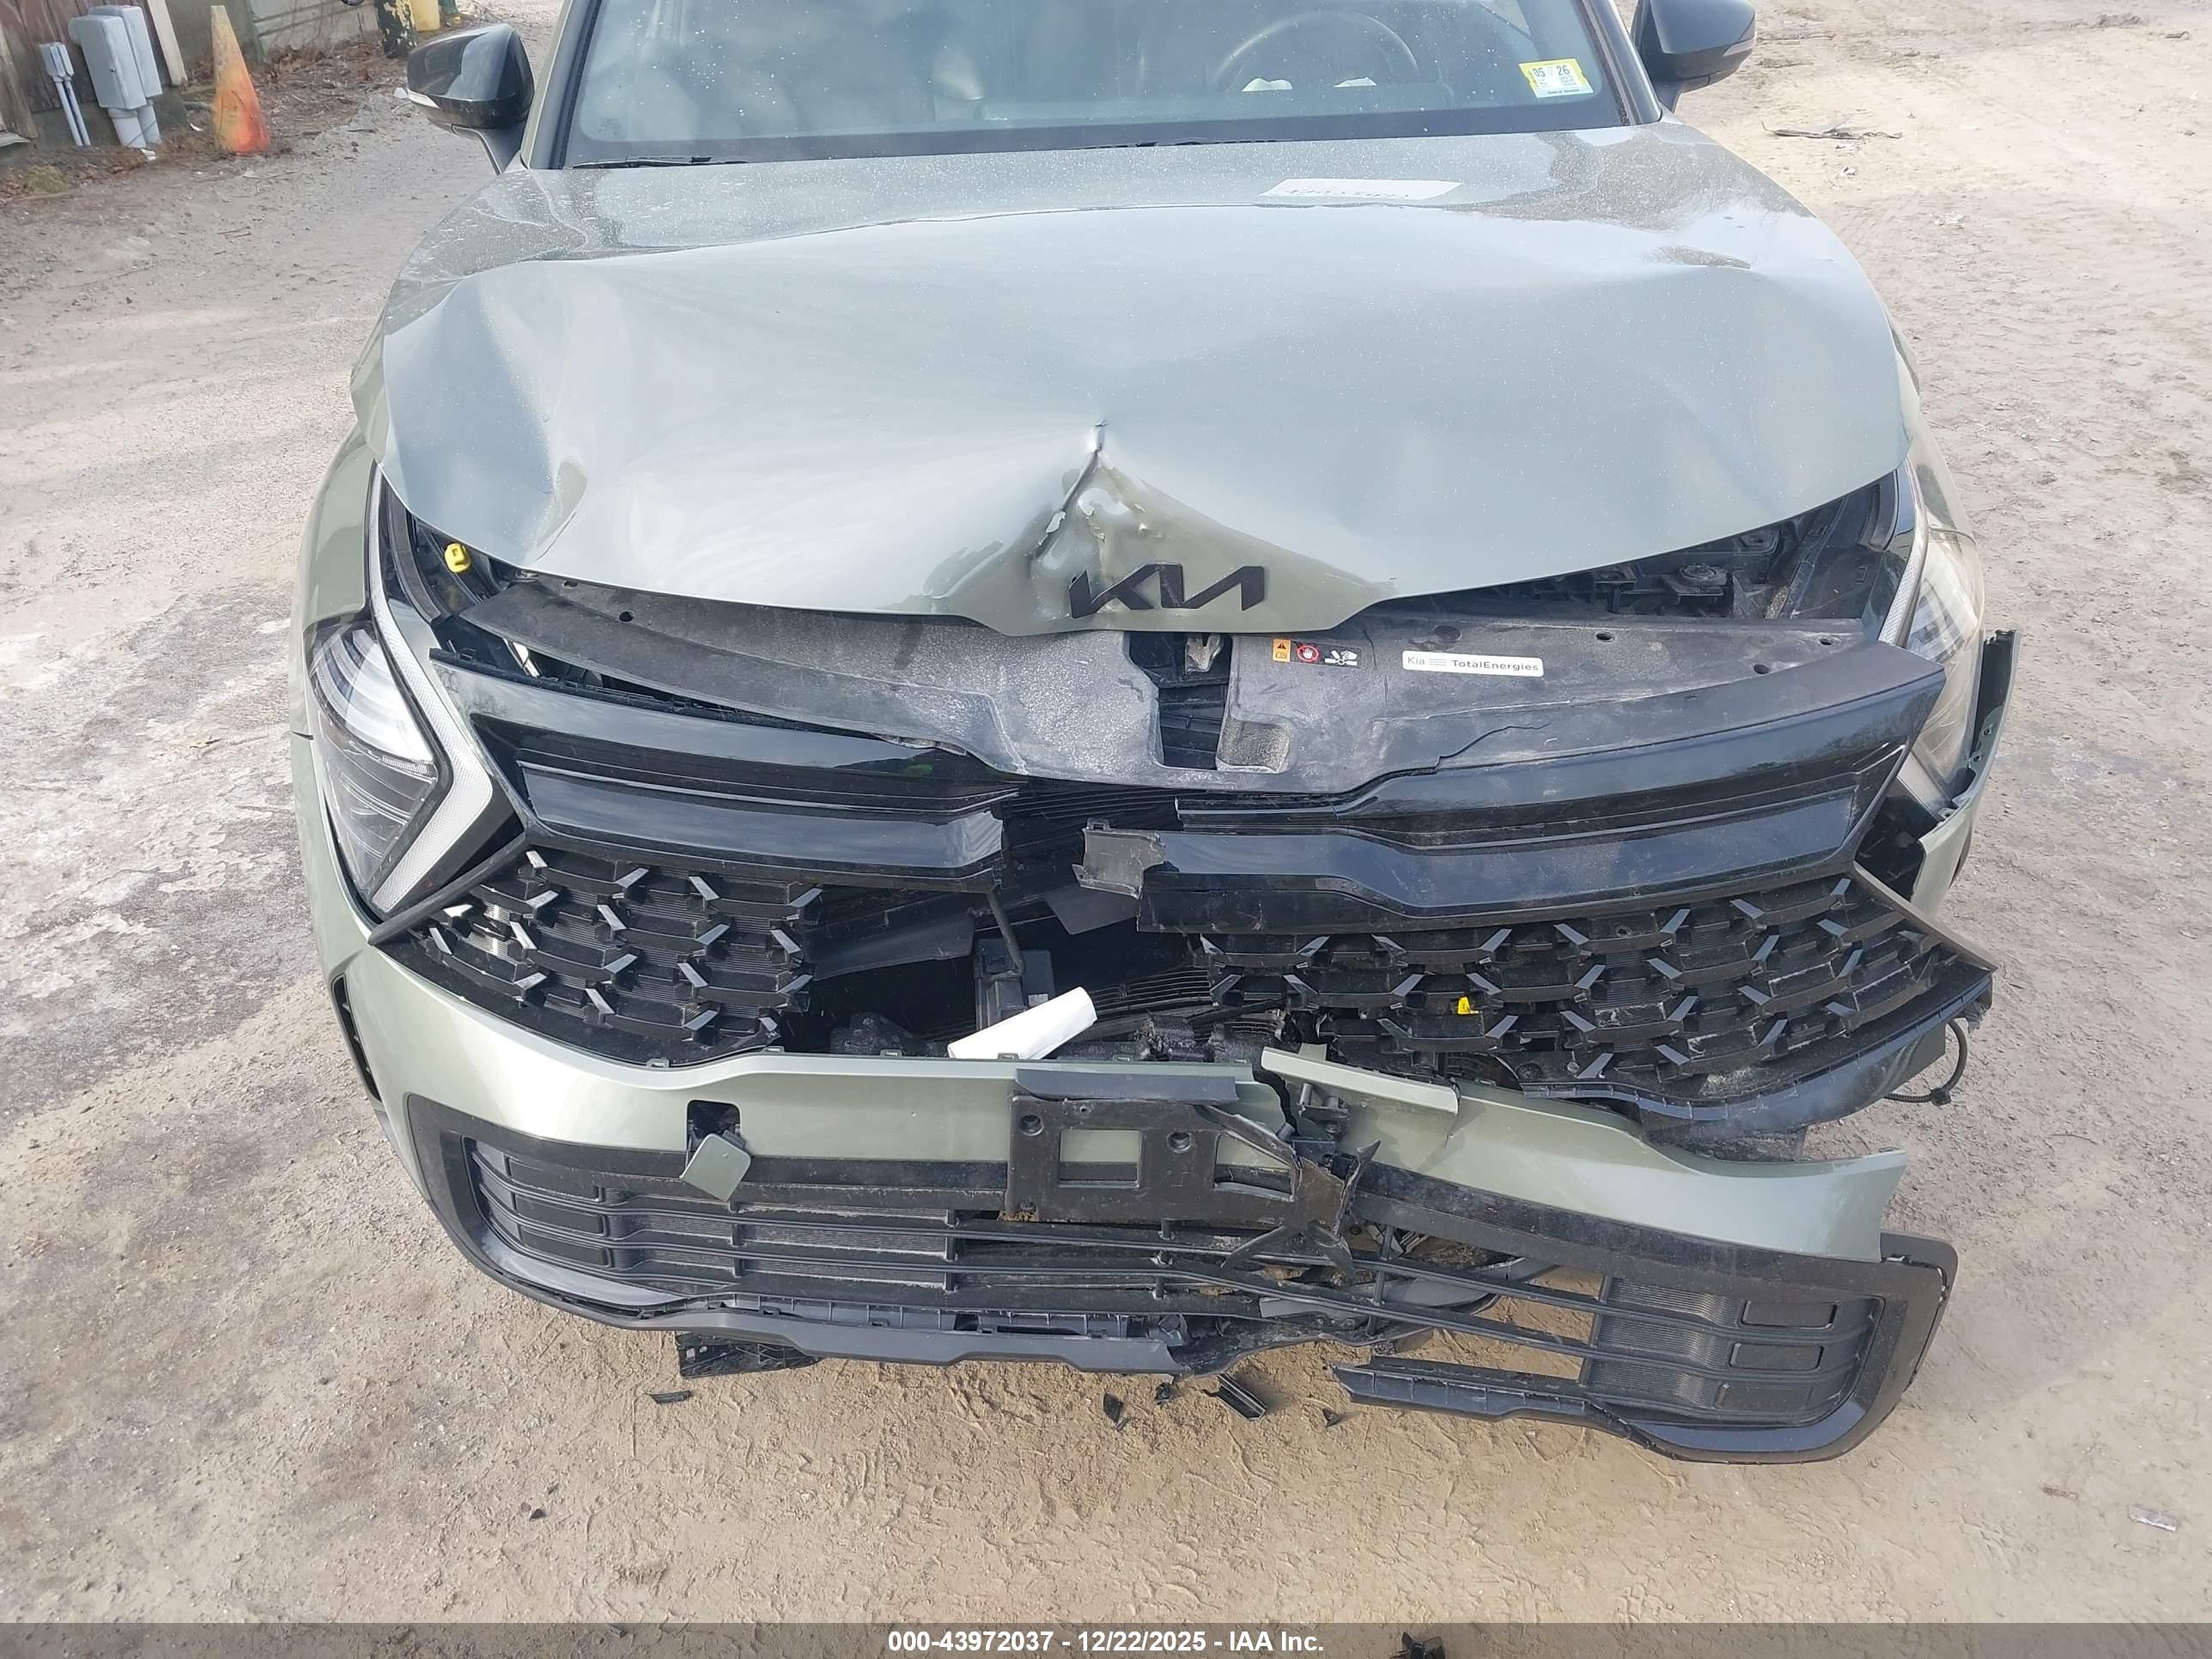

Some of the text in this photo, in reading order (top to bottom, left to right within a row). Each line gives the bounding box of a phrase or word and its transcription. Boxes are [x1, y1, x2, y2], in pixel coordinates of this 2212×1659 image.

[1532, 64, 1571, 77] 05 26
[1068, 562, 1266, 619] KIA
[1407, 656, 1540, 672] Kia TotalEnergies
